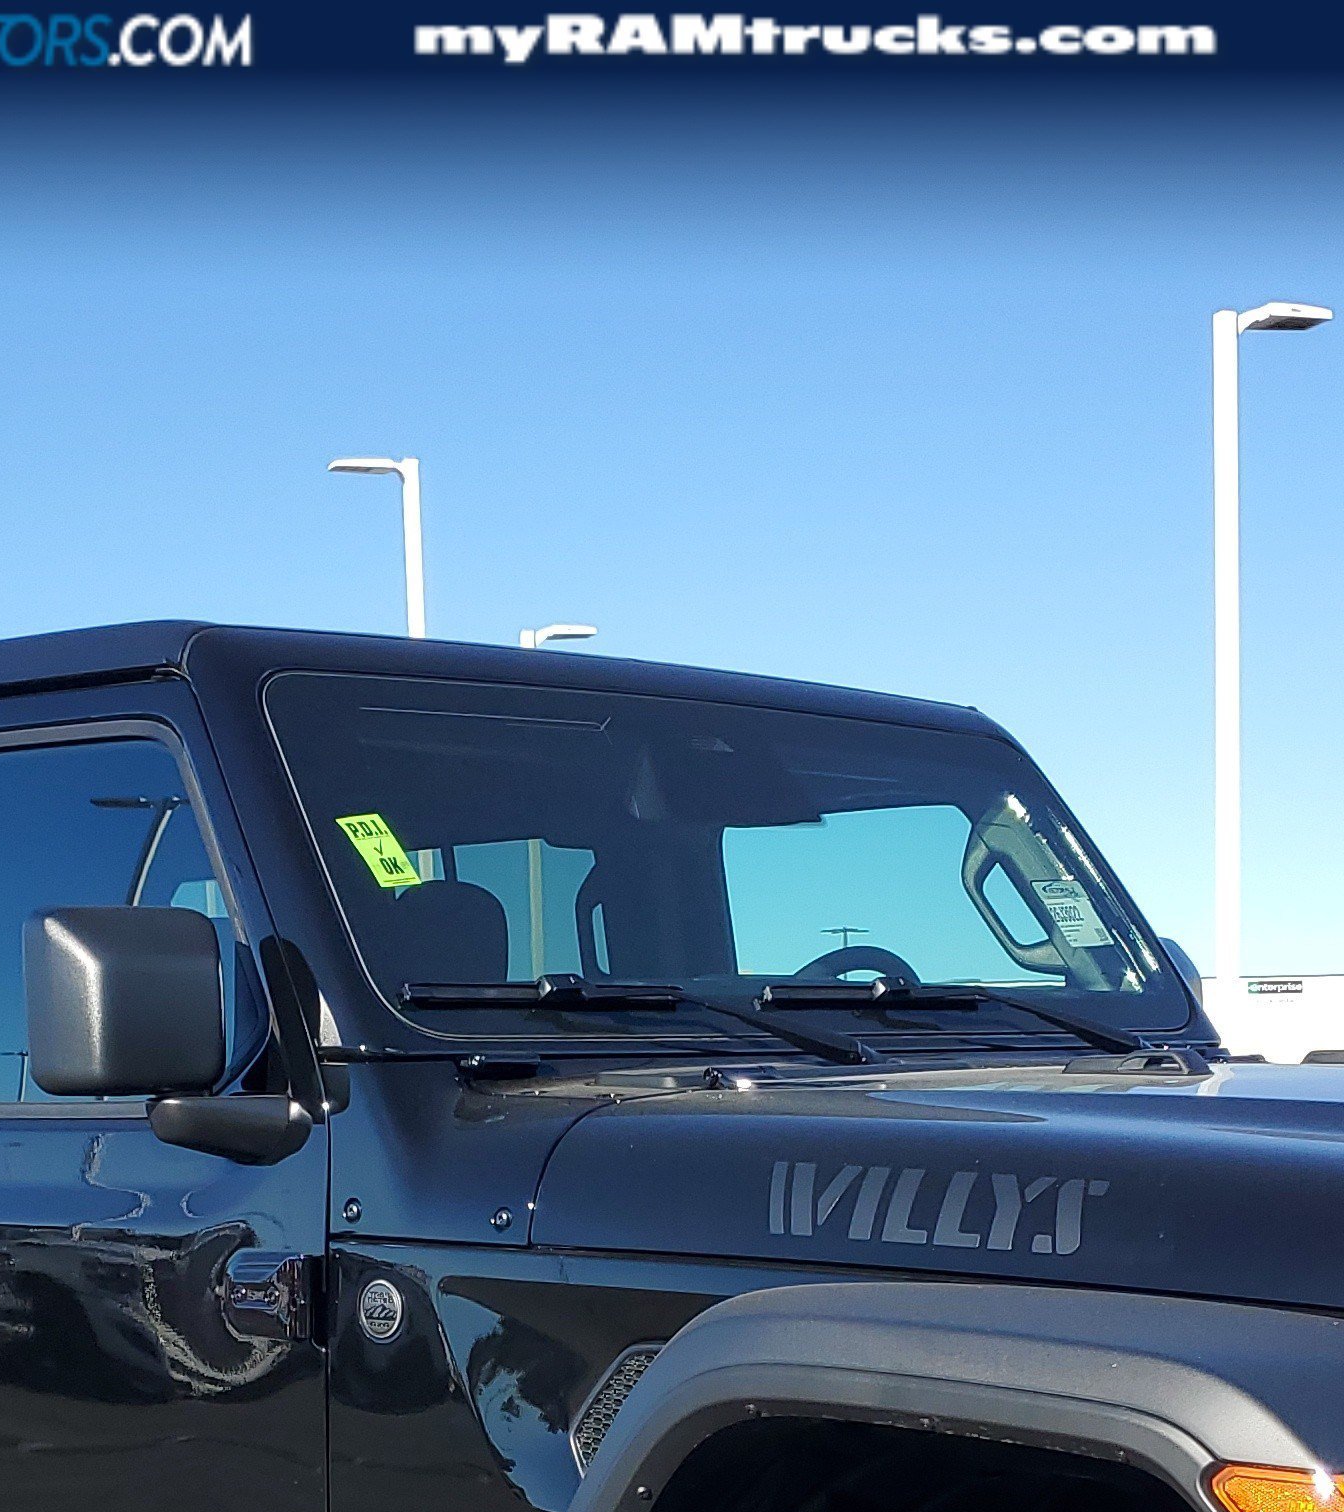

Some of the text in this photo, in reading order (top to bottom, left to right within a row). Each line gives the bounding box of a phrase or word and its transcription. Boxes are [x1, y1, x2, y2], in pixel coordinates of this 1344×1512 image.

[345, 820, 389, 838] P.D.I.
[379, 856, 405, 875] OK
[769, 1160, 1111, 1256] WILLYS
